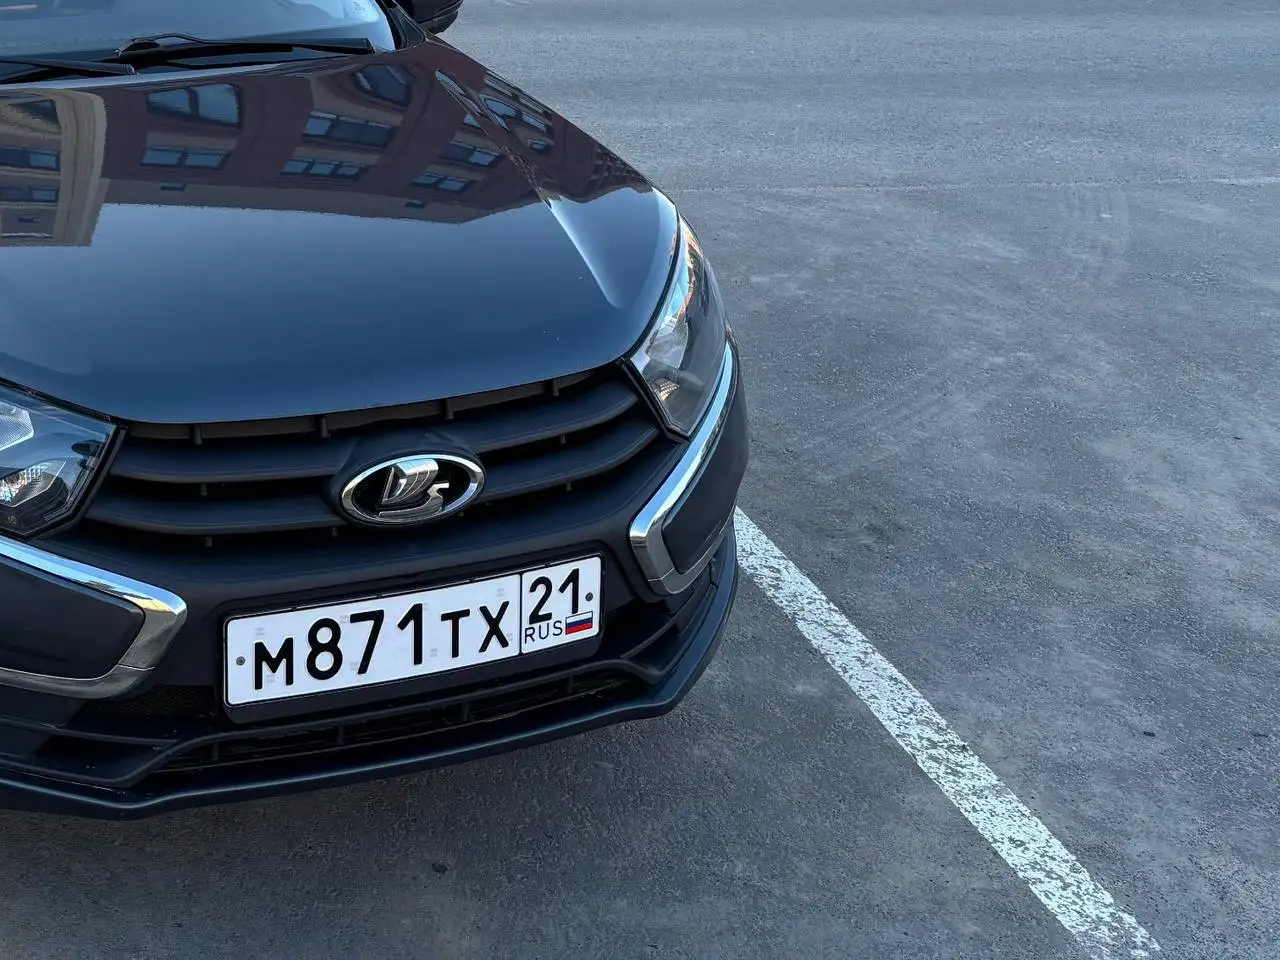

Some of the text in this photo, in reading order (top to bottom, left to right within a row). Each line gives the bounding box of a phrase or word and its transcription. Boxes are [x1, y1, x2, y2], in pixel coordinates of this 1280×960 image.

[254, 568, 580, 690] М871ТХ 21
[524, 619, 564, 644] RUS
